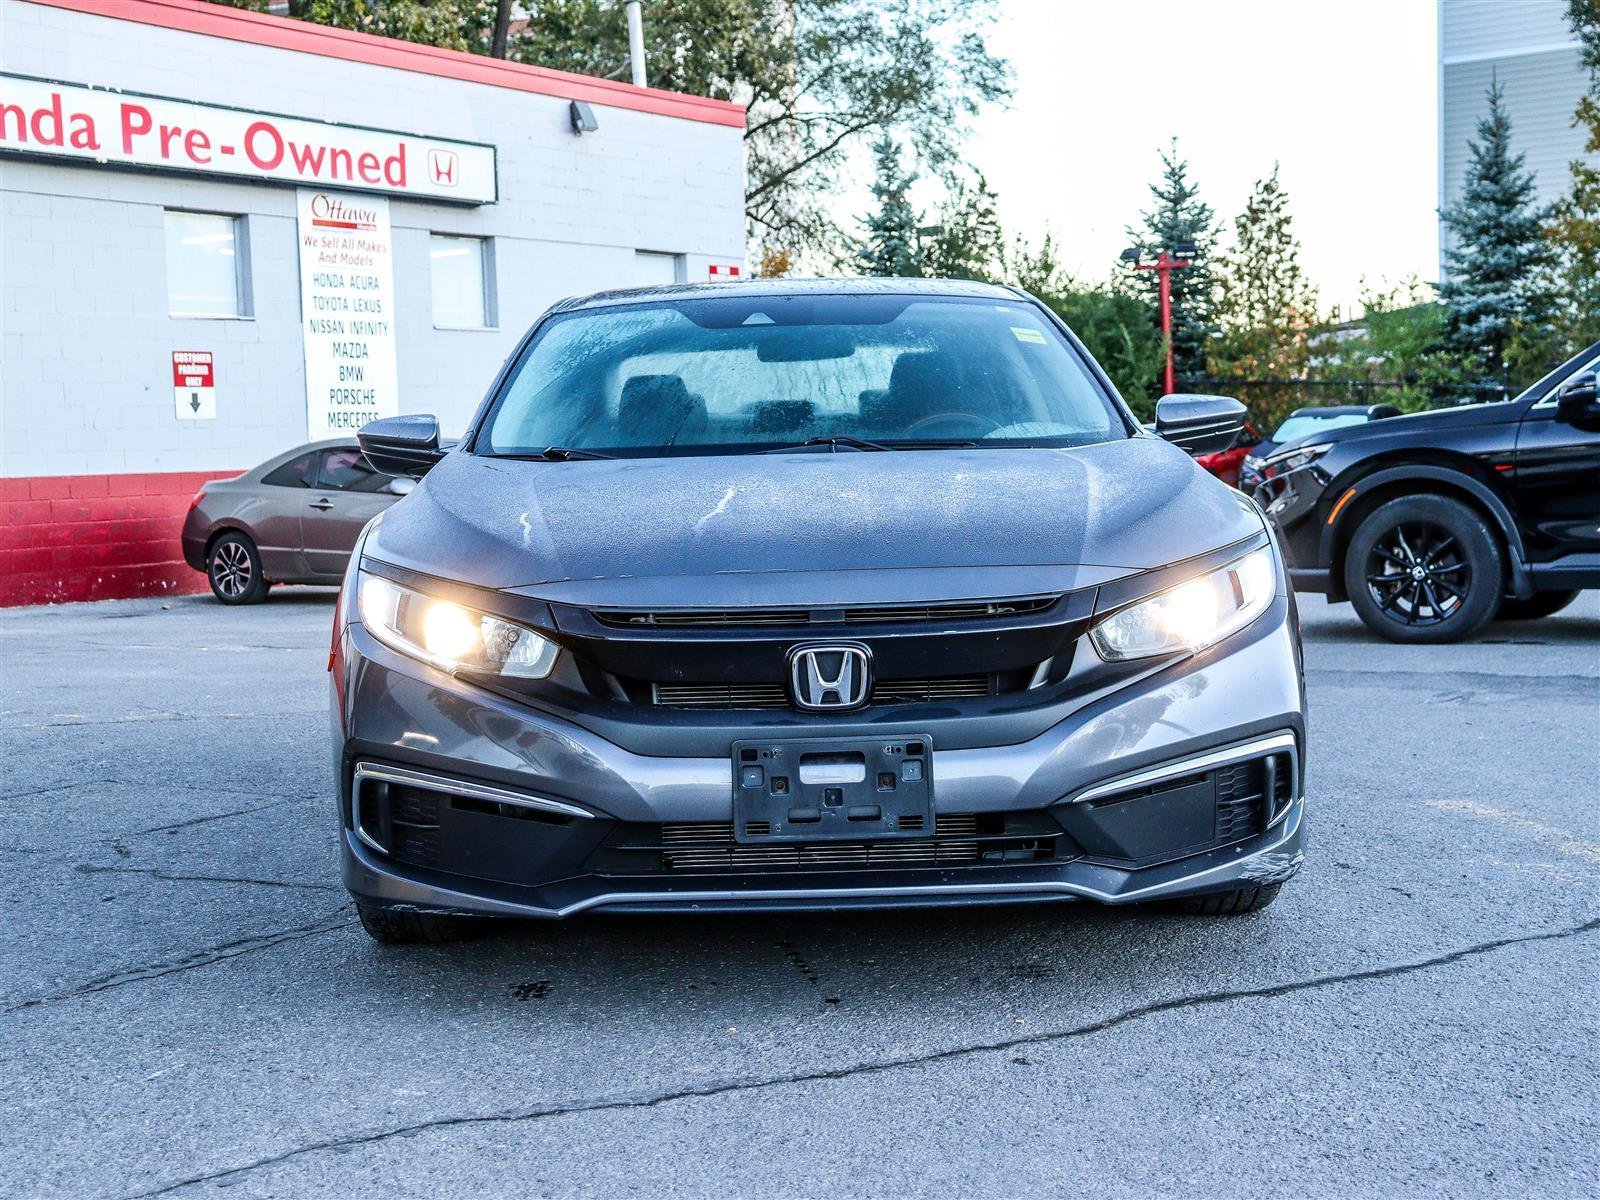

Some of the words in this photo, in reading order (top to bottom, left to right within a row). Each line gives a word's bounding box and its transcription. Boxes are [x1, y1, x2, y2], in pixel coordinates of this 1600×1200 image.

[121, 103, 406, 187] Pre-Owned
[312, 193, 376, 222] Ottawa
[304, 235, 318, 247] We
[321, 237, 338, 249] Sell
[341, 239, 355, 251] All
[357, 241, 387, 253] Makes
[318, 251, 337, 264] And
[340, 253, 373, 266] Models
[313, 272, 344, 288] HONDA
[350, 275, 380, 290] ACURA
[313, 296, 348, 311] TOYOTA
[353, 298, 382, 313] LEXUS
[310, 319, 344, 334] NISSAN
[350, 320, 388, 335] INFINITY
[333, 342, 368, 358] MAZDA
[339, 365, 364, 382] BMW
[330, 388, 376, 405] PORSCHE
